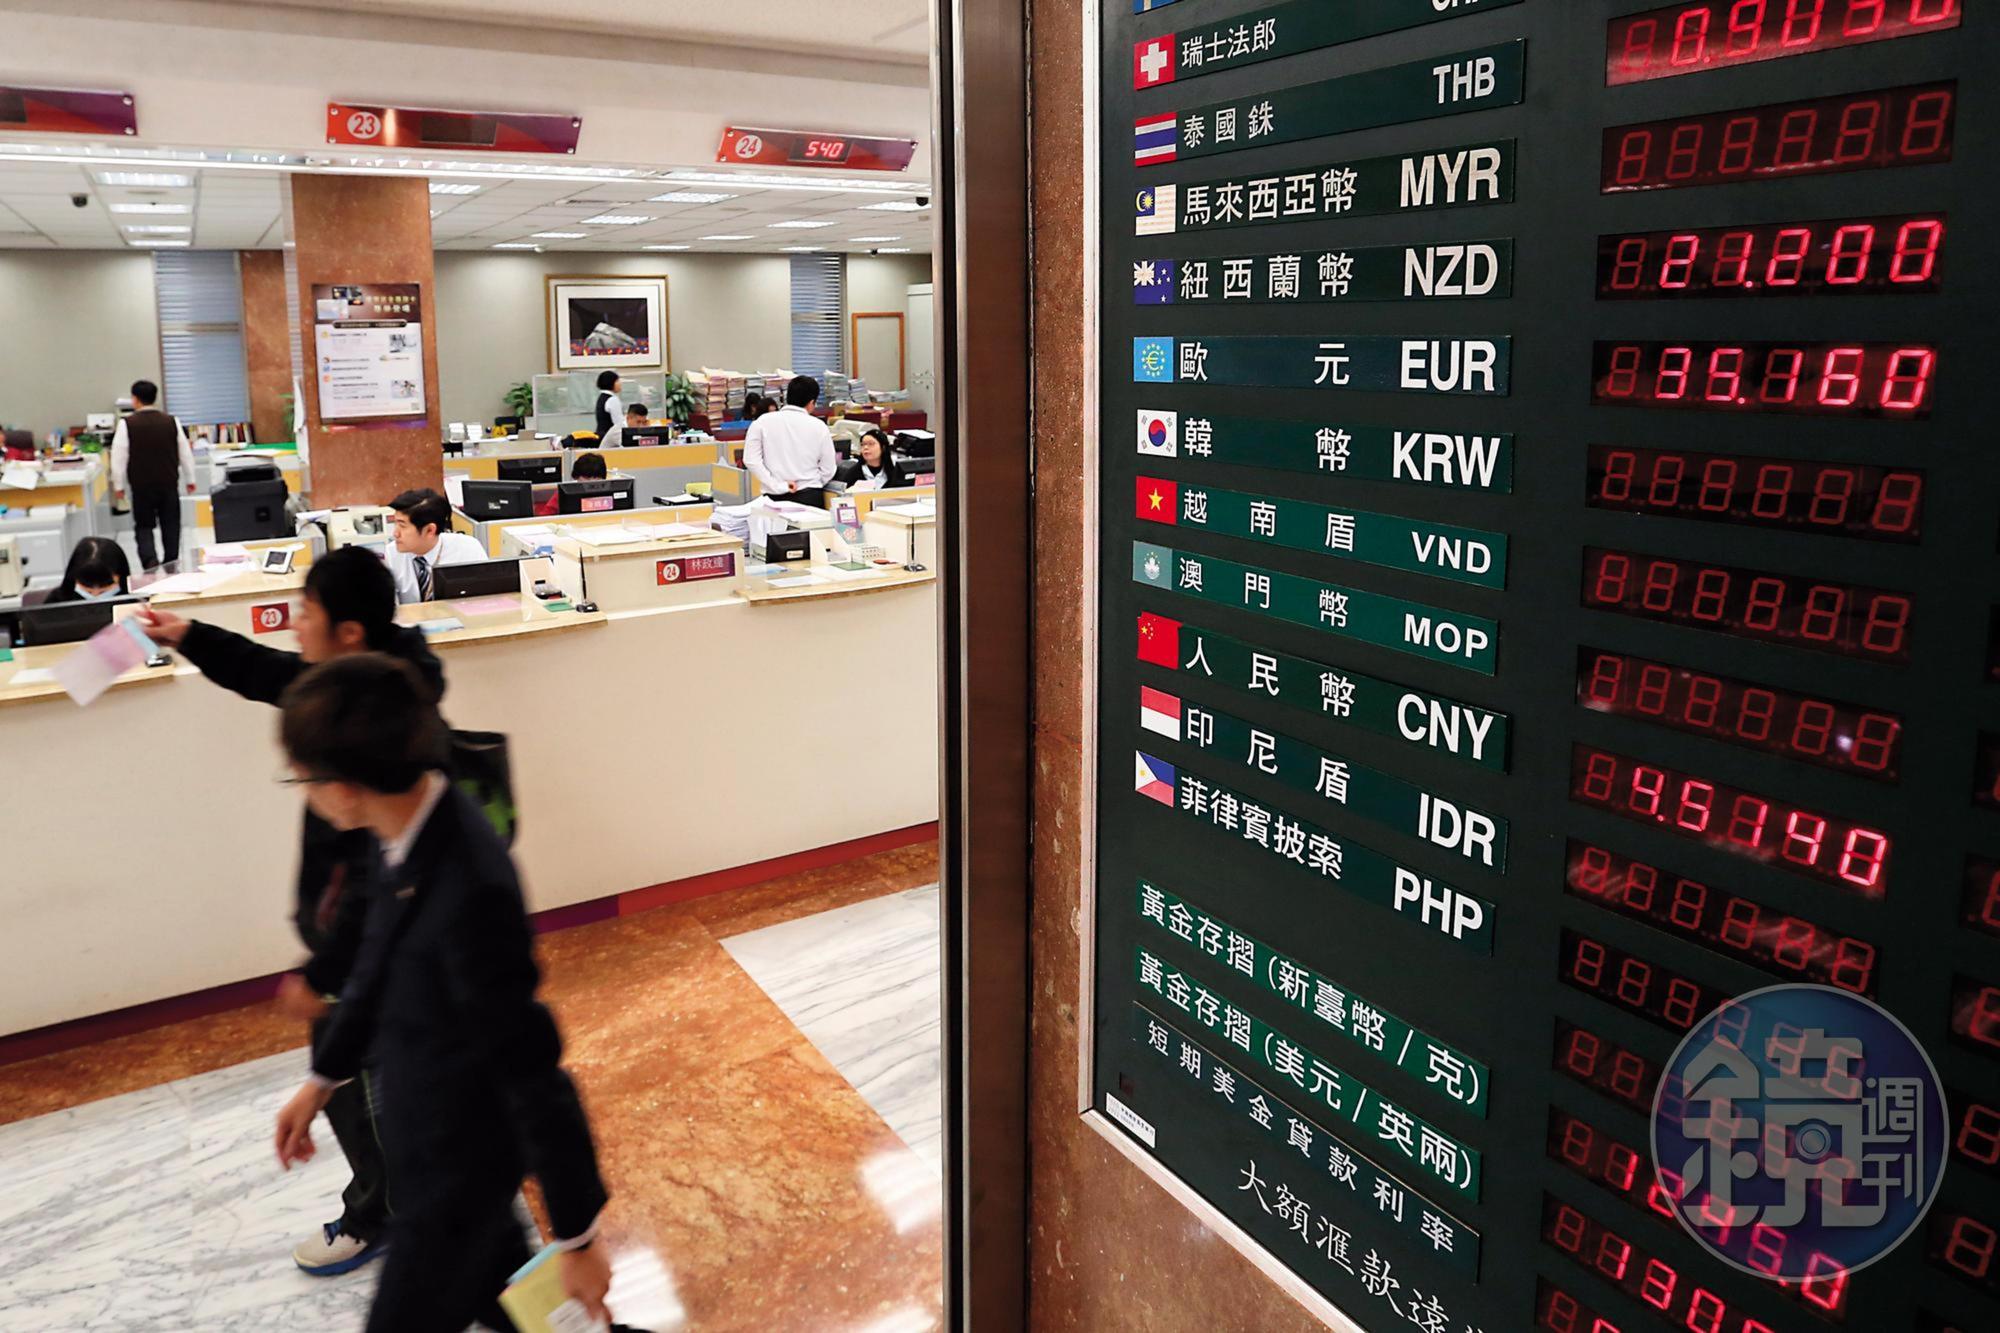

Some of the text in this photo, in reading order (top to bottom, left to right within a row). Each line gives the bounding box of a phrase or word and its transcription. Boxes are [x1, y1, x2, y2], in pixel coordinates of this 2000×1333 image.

[1182, 19, 1276, 68] 瑞士法郎
[353, 114, 376, 136] 23
[1184, 57, 1495, 148] 泰國銖 THB
[739, 136, 759, 155] 24
[805, 140, 844, 158] 540
[1183, 147, 1500, 225] 馬來西亞幣 MYR
[1181, 244, 1498, 300] 紐西蘭幣 NZD
[1659, 219, 1943, 289] 21.200
[1401, 340, 1497, 391] EUR
[1655, 347, 1937, 409] 35.160
[1392, 431, 1500, 487] KRW
[1183, 489, 1491, 574] 越南盾 VND
[1179, 557, 1488, 658] 澳門幣 MOP
[1185, 637, 1494, 761] 人民幣 CNY
[1187, 708, 1496, 867] 印尼盾 IDR
[1181, 776, 1484, 940] 菲律賓披索 PHP
[1631, 766, 1888, 887] 4.5140
[1148, 1020, 1453, 1253] 短期美金貸款利率
